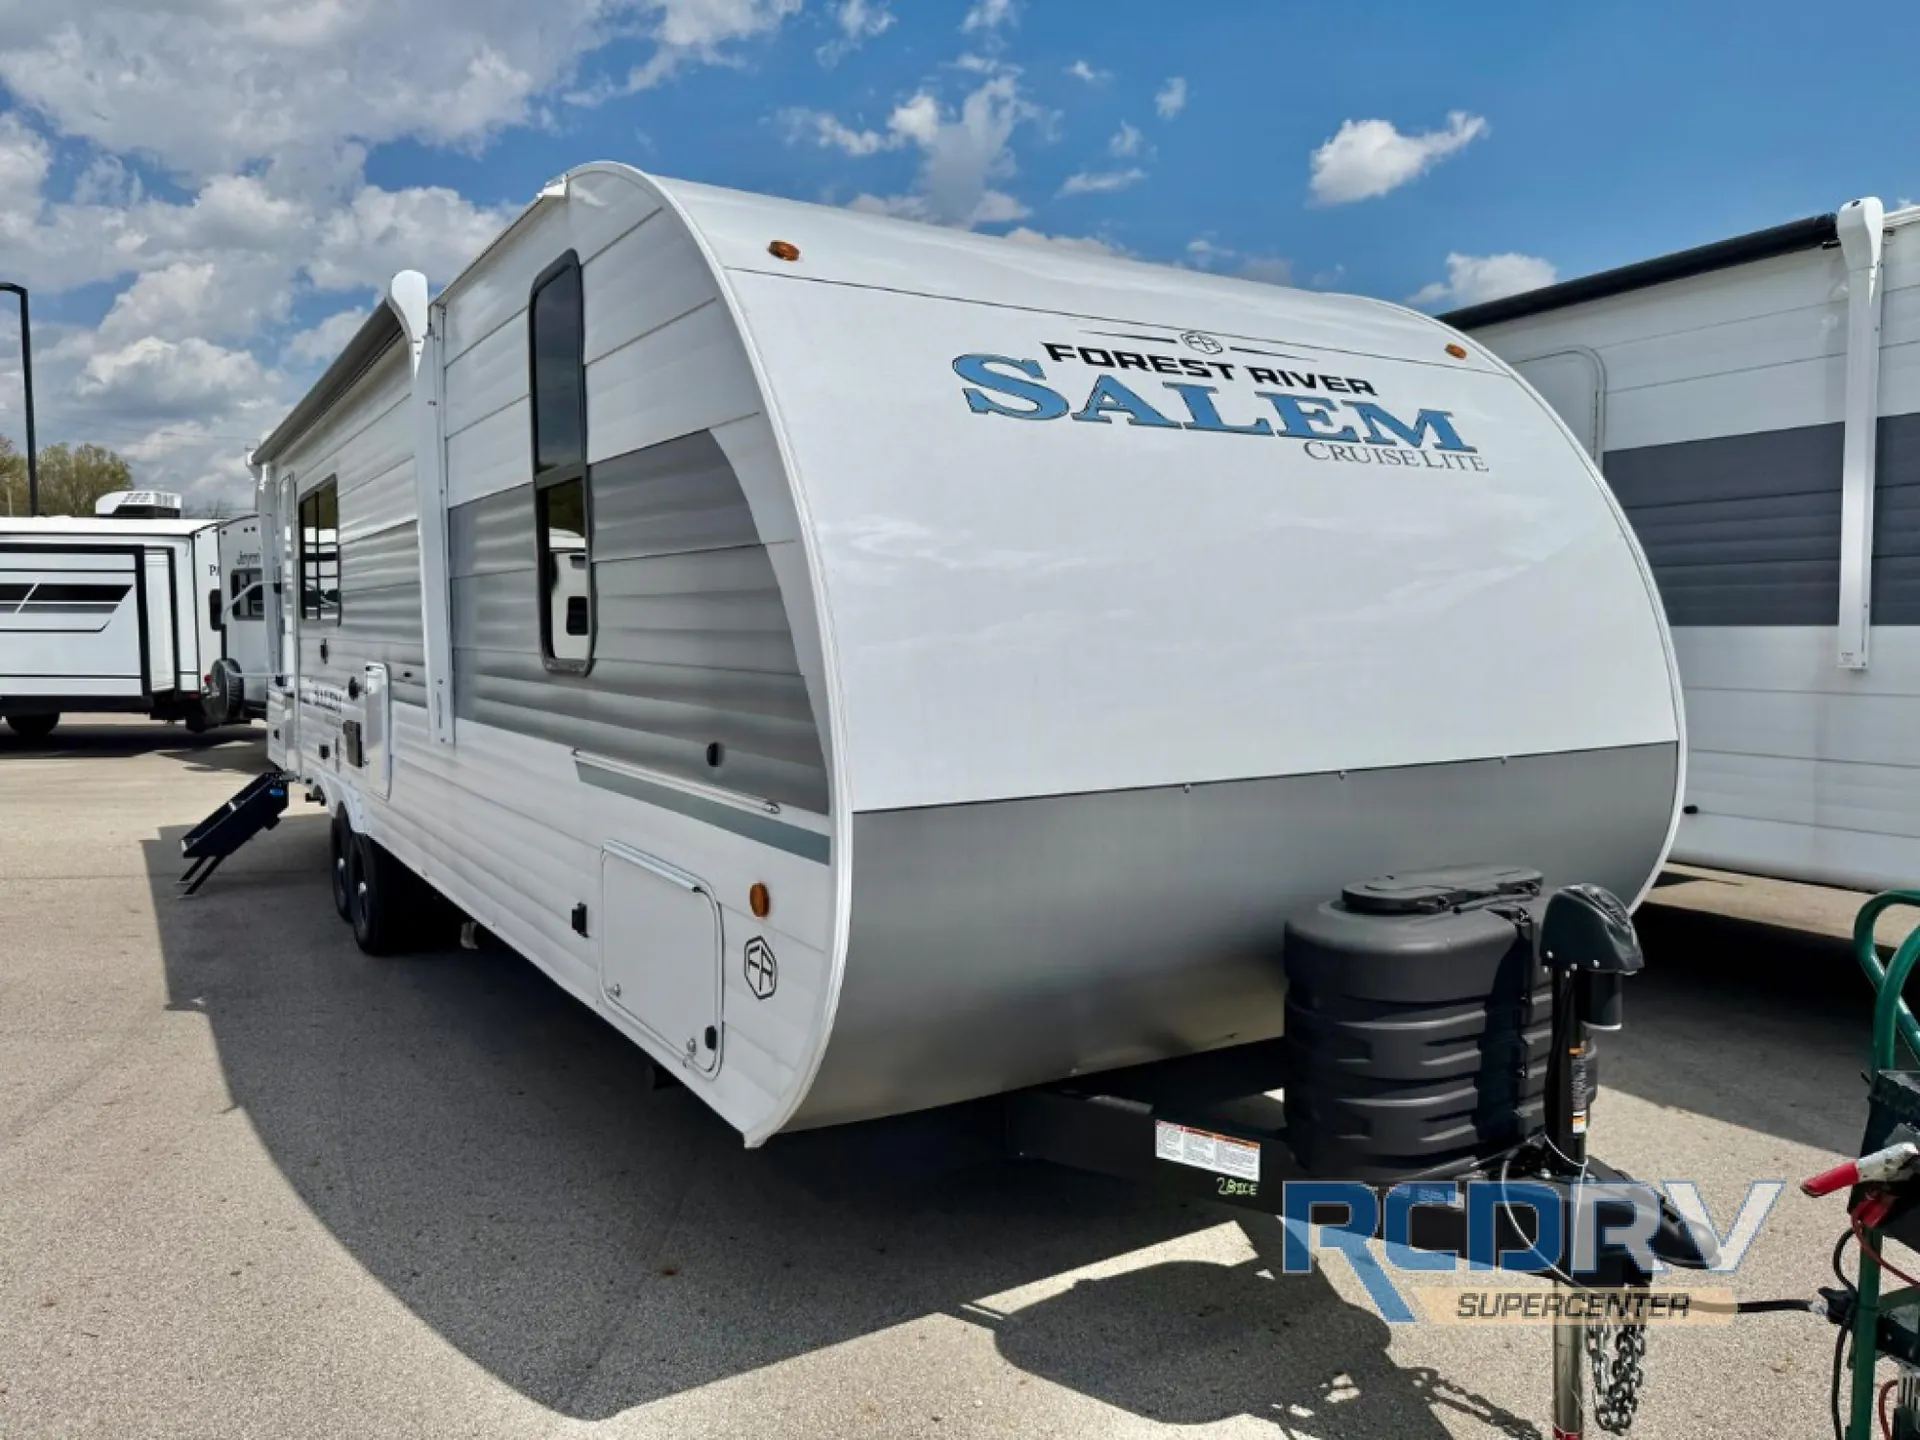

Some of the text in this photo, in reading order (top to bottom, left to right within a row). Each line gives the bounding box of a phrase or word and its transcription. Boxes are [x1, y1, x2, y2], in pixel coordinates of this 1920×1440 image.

[952, 353, 1478, 454] SALEM
[1040, 341, 1378, 396] FOREST RIVER
